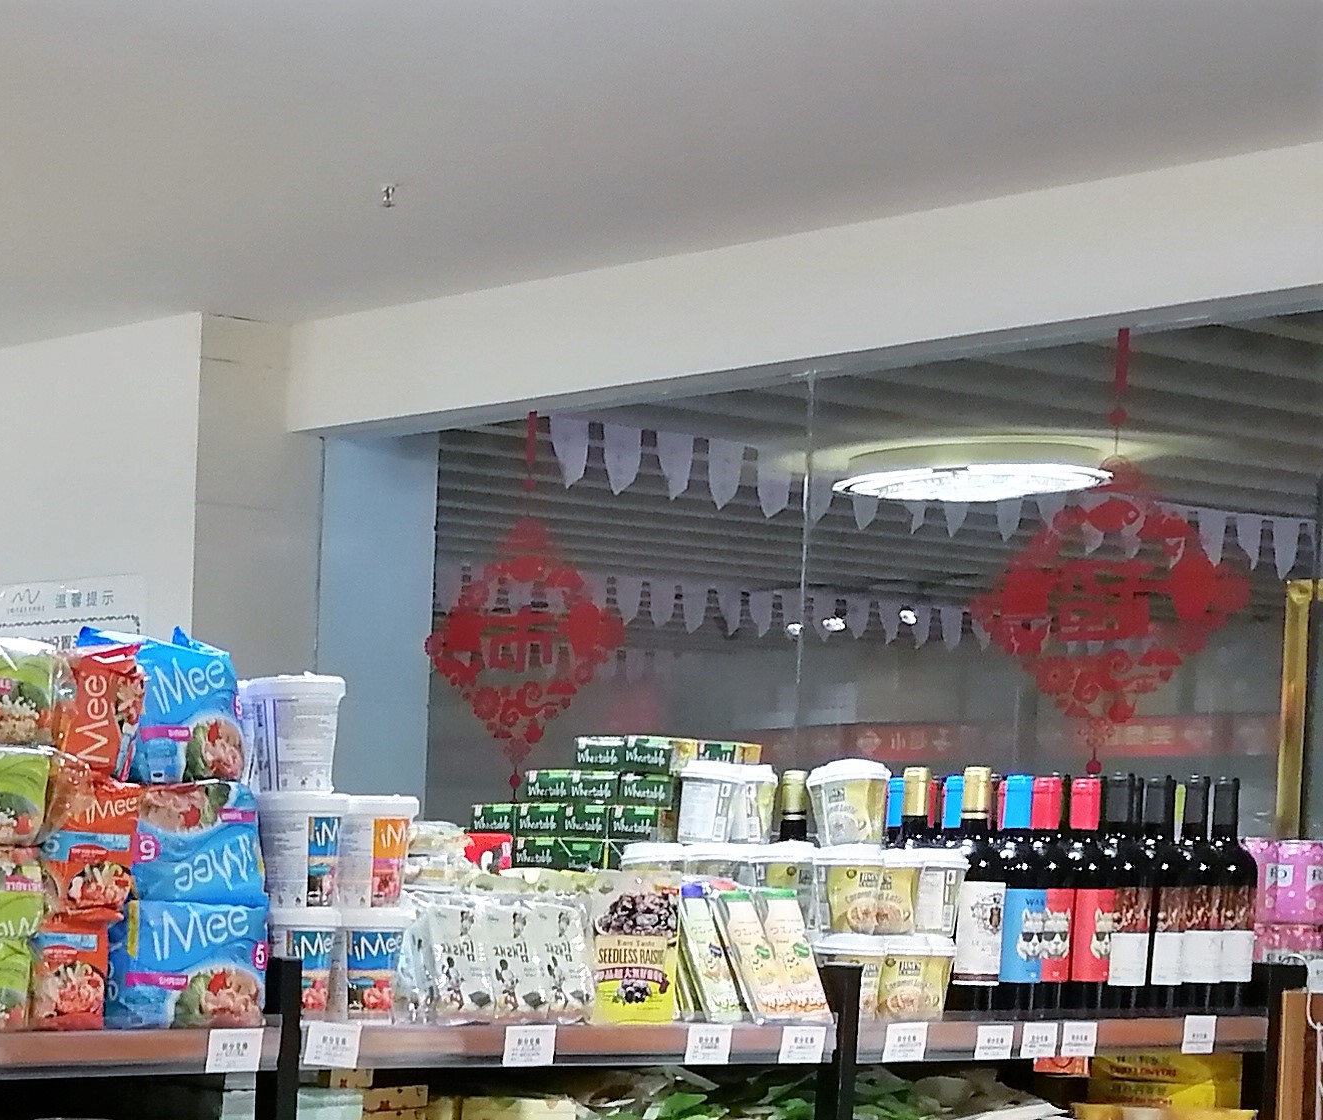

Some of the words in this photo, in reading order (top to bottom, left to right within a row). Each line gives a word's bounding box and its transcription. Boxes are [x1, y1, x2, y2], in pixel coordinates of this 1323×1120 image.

[152, 658, 227, 715] iMee
[174, 834, 252, 891] iMee
[153, 907, 249, 962] iMee
[598, 949, 638, 964] SEEDLESS
